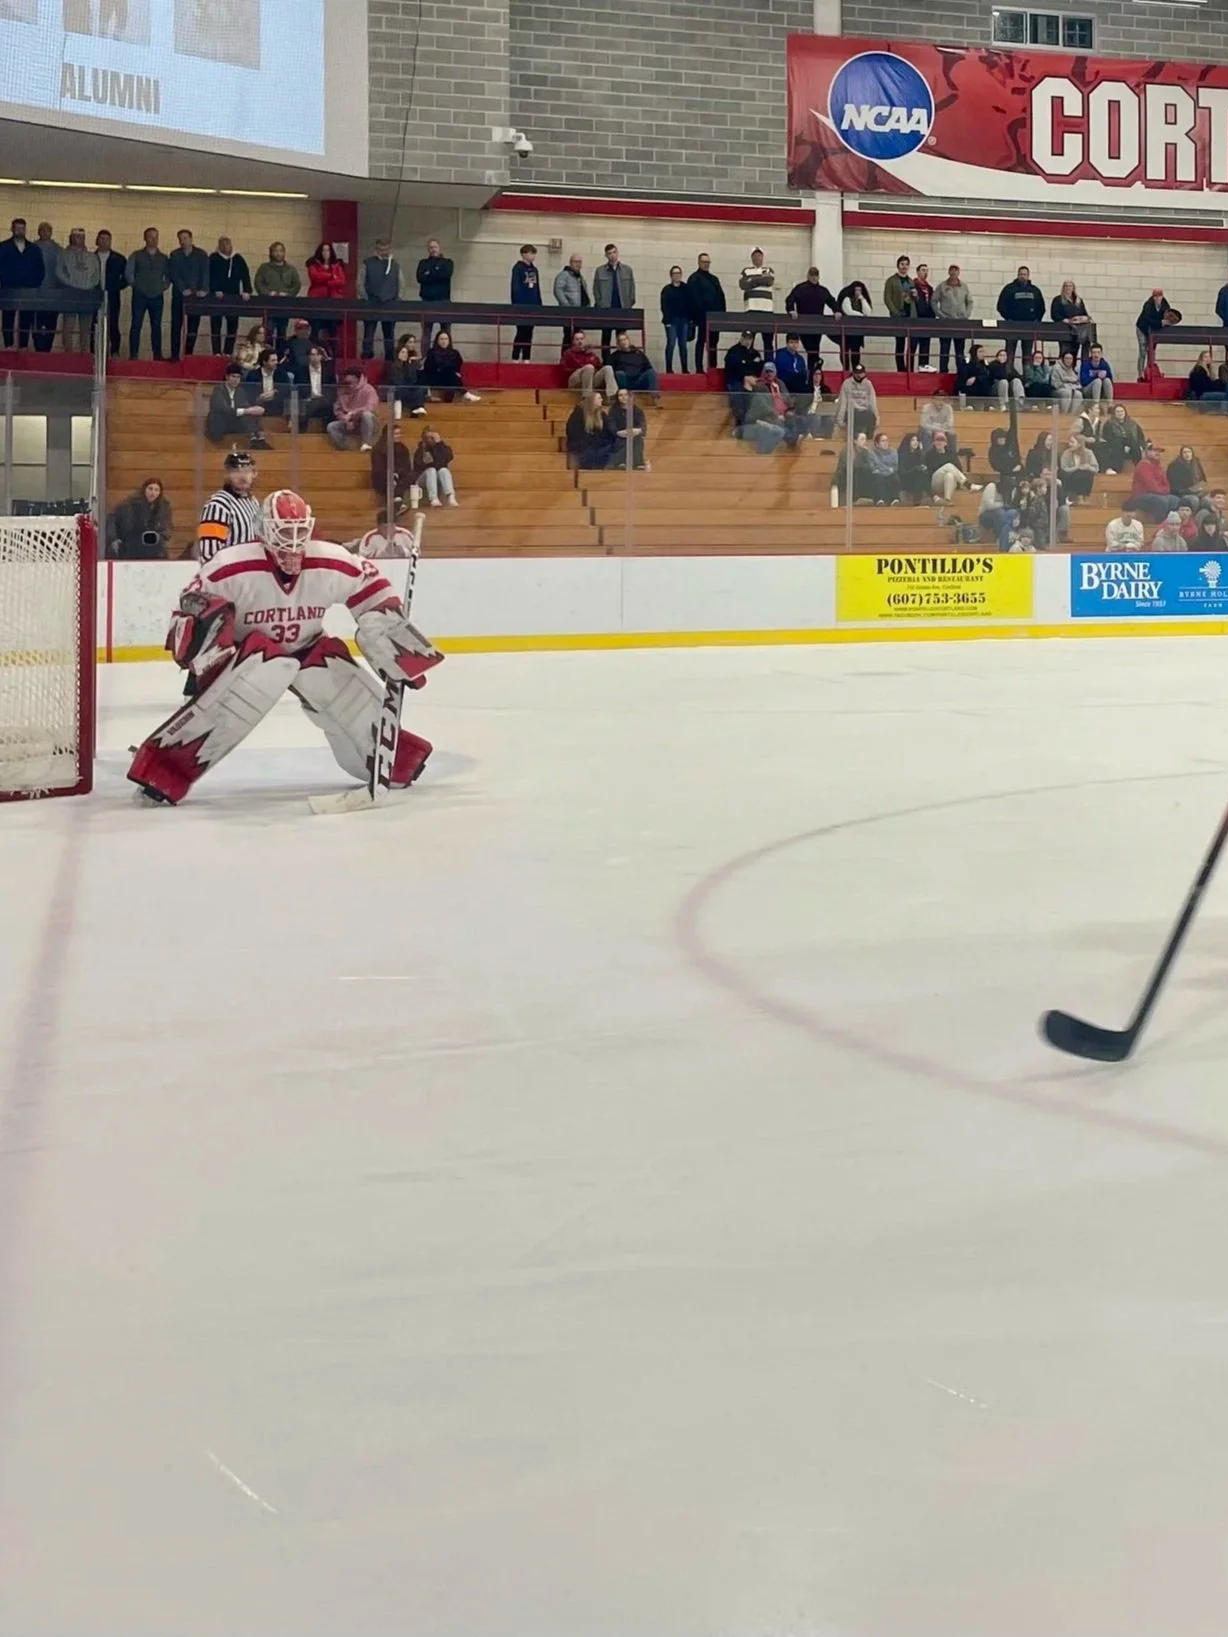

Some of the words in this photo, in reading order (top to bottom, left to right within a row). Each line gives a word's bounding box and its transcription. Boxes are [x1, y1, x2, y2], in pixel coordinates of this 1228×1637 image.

[60, 62, 160, 115] ALUMNI
[841, 103, 929, 135] NCAA
[876, 558, 994, 575] PONTILLO'S
[1080, 562, 1151, 590] BYRNE
[937, 575, 984, 583] RESTAURANT
[1101, 581, 1163, 600] DAIRY
[244, 606, 326, 625] CORTLAND
[270, 623, 301, 644] 33
[376, 677, 400, 790] CCM
